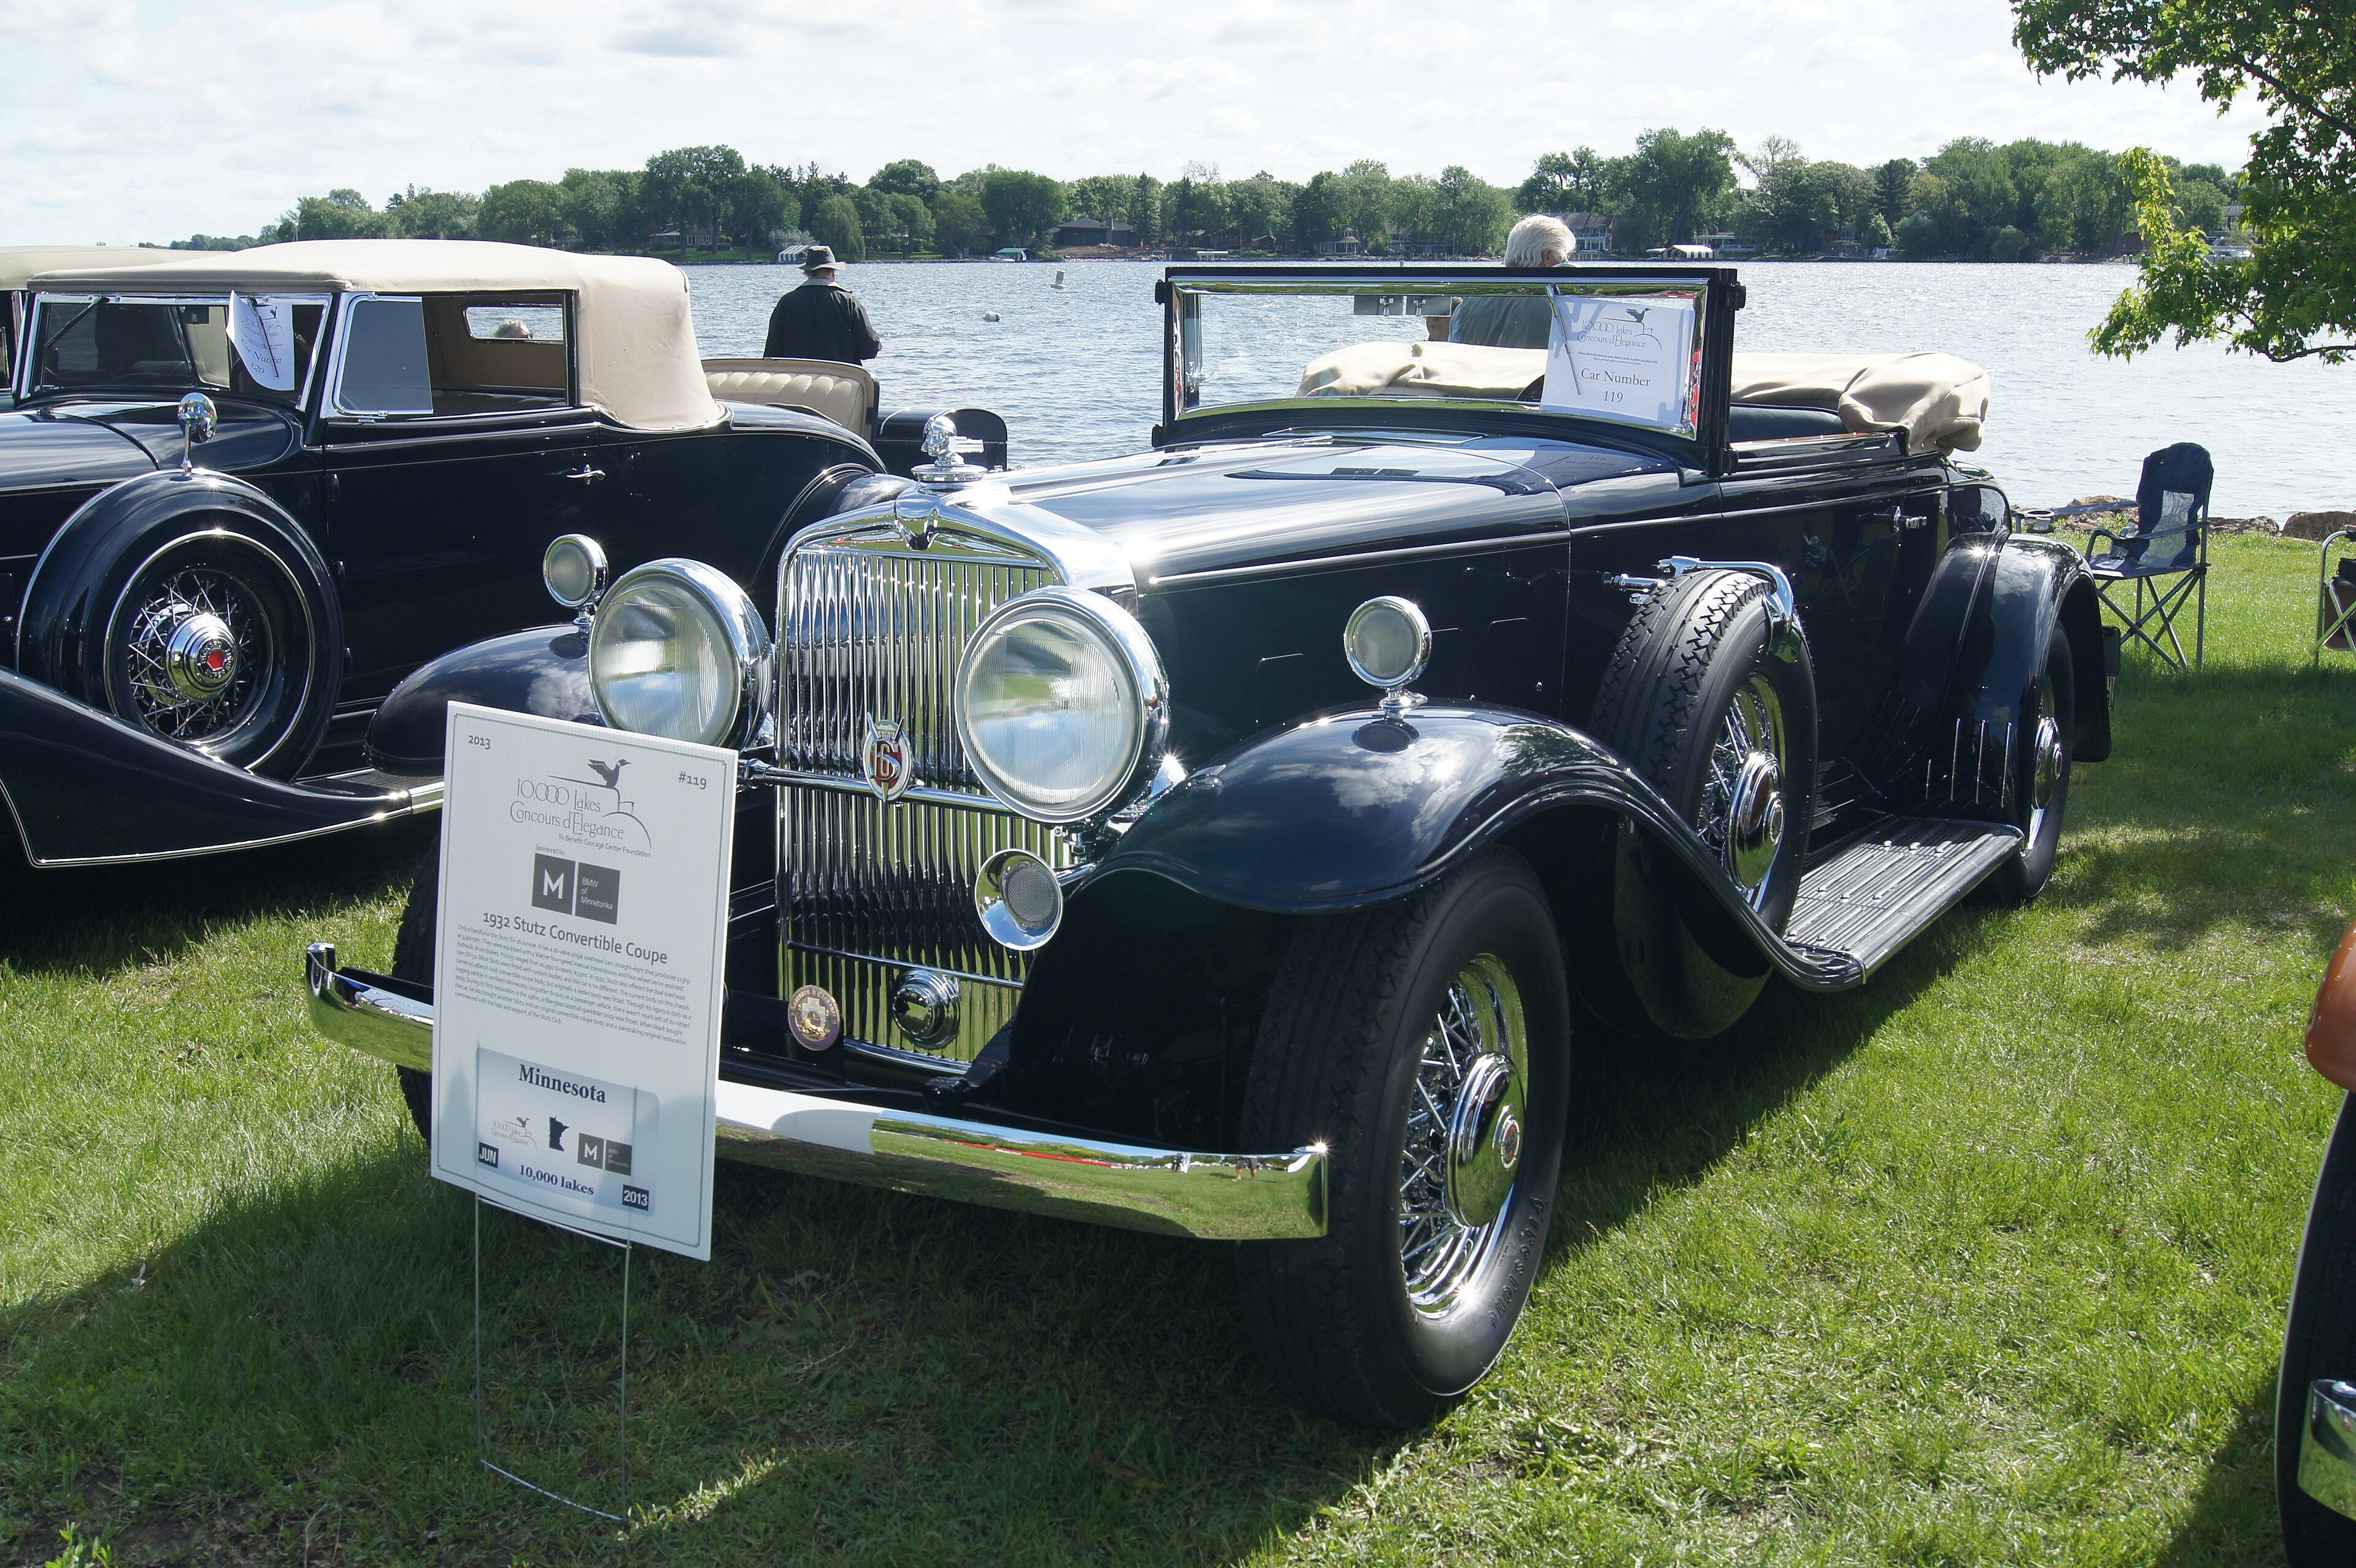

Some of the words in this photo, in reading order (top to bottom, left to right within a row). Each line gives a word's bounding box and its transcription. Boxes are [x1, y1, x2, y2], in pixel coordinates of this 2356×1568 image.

[1577, 331, 1608, 343] Concours
[1609, 334, 1647, 348] d'Elegance
[1581, 367, 1601, 380] Car
[1603, 371, 1651, 386] Number
[1604, 390, 1623, 403] 119
[468, 735, 490, 750] 2013
[678, 771, 707, 790] #119
[517, 778, 569, 805] 10,000
[574, 789, 601, 812] Lakes
[510, 801, 560, 827] Concours
[563, 811, 624, 839] d'Elegance
[535, 844, 559, 854] Sponsored
[565, 835, 583, 844] Benefit
[583, 838, 604, 850] Courage
[605, 843, 622, 852] Center
[622, 846, 651, 858] Foundation
[543, 869, 564, 899] M
[582, 877, 598, 887] BMW
[580, 896, 613, 910] Minnetonka
[483, 912, 510, 929] 1932
[514, 916, 546, 936] Stutz
[550, 924, 622, 954] Convertible
[626, 942, 667, 966] Coupe
[518, 1064, 606, 1103] Minnesota
[479, 1147, 496, 1164] JUN
[584, 1142, 598, 1160] M
[520, 1165, 558, 1185] 10,000
[561, 1176, 594, 1195] lakes
[623, 1189, 647, 1206] 2013
